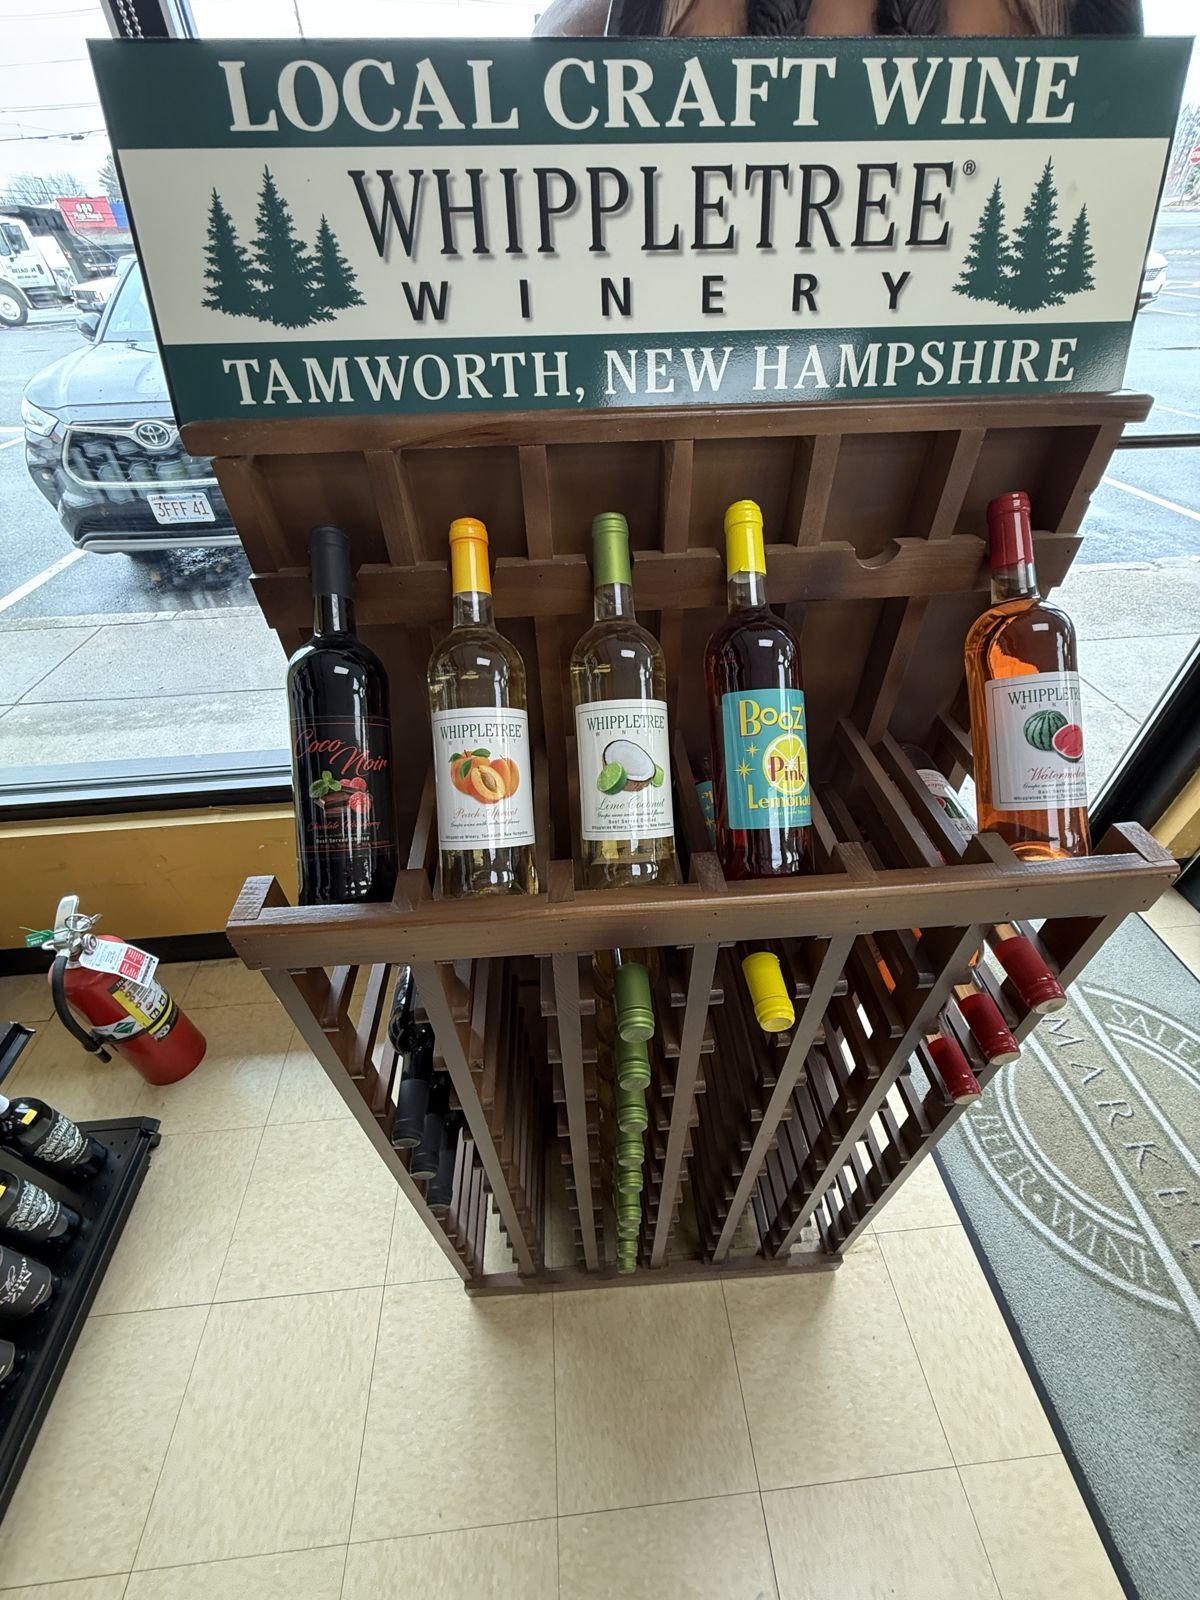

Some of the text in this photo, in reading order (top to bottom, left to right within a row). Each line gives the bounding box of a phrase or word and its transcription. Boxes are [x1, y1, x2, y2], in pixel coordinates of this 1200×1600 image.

[217, 55, 1079, 132] LOCAL CRAFT WINE
[401, 271, 911, 321] WINERY
[222, 337, 1077, 406] TAMWORTH, NEW HAMPSHIRE
[154, 500, 210, 517] 3FFF 41
[440, 723, 522, 740] WHIPPLETREE
[586, 714, 665, 732] WHIPPLETREE
[737, 699, 805, 737] Booz
[293, 729, 345, 759] Coco
[329, 746, 388, 777] Noir
[769, 755, 806, 783] Pink
[971, 1114, 1038, 1201] BEER
[1052, 1197, 1162, 1292] WINE
